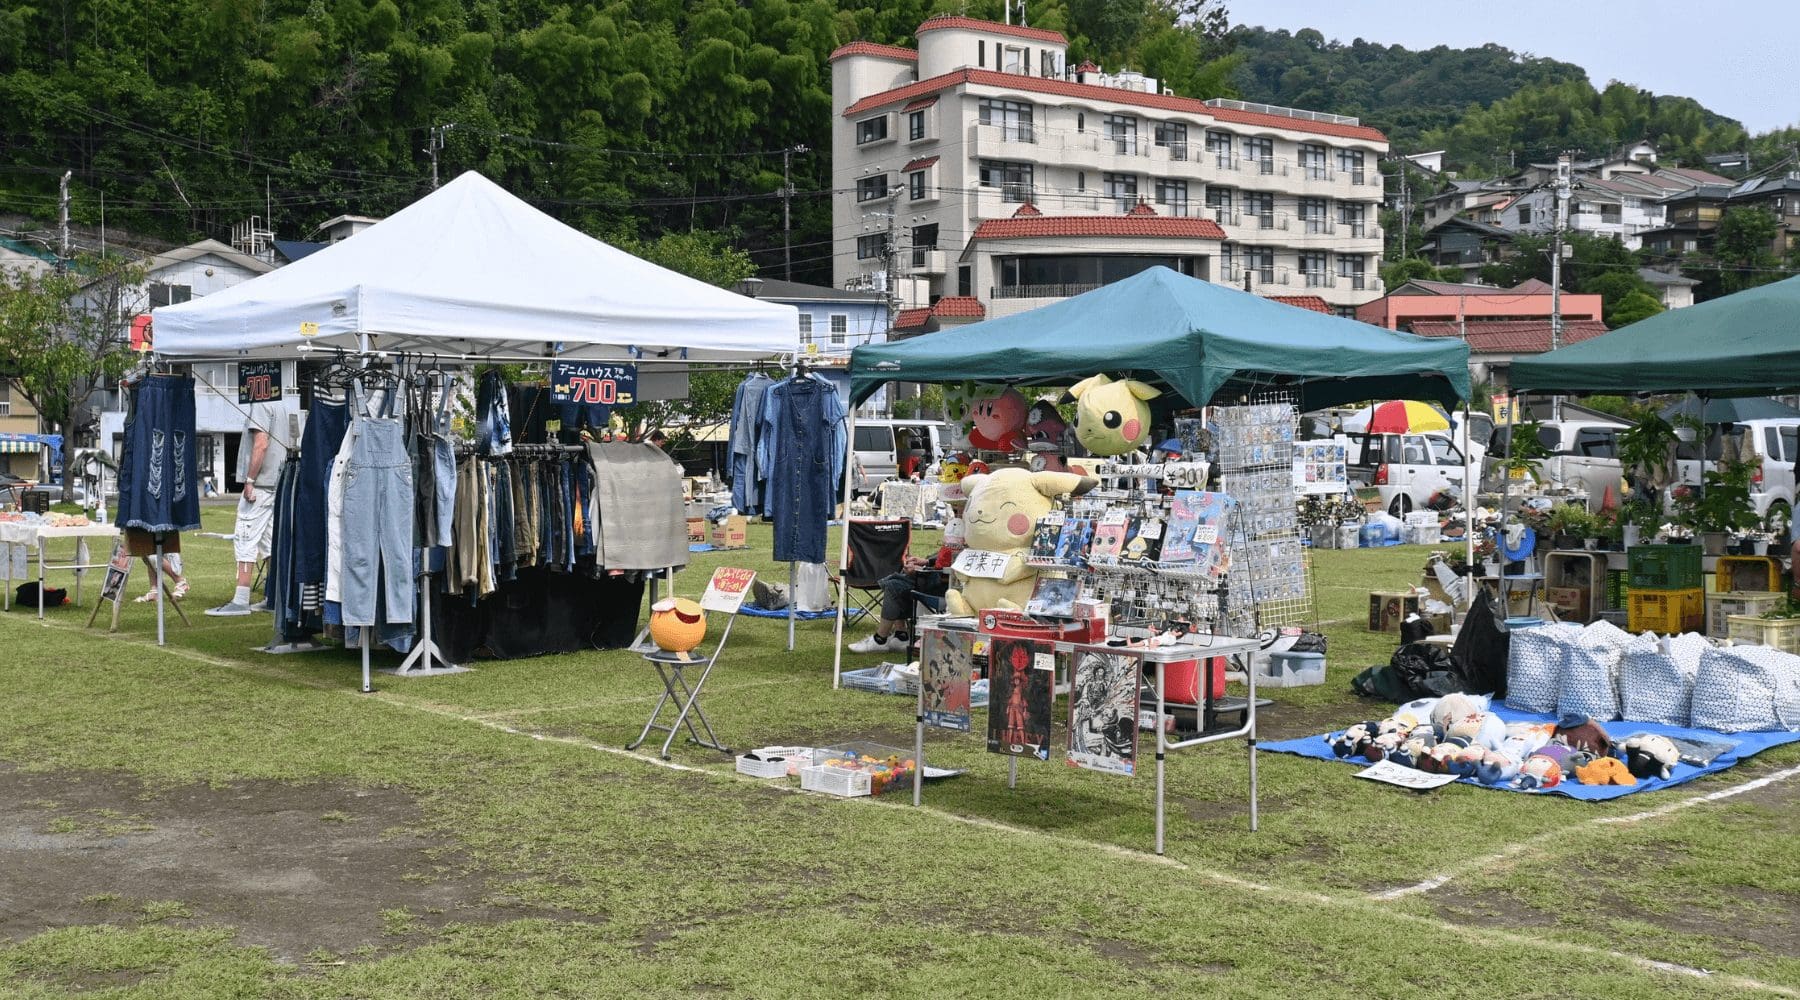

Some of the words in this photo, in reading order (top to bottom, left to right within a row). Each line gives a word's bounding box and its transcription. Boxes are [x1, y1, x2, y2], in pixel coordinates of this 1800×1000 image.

[558, 363, 613, 379] デニムハウス
[246, 374, 272, 401] 700
[569, 376, 617, 405] 700
[963, 551, 1004, 573] 営業中
